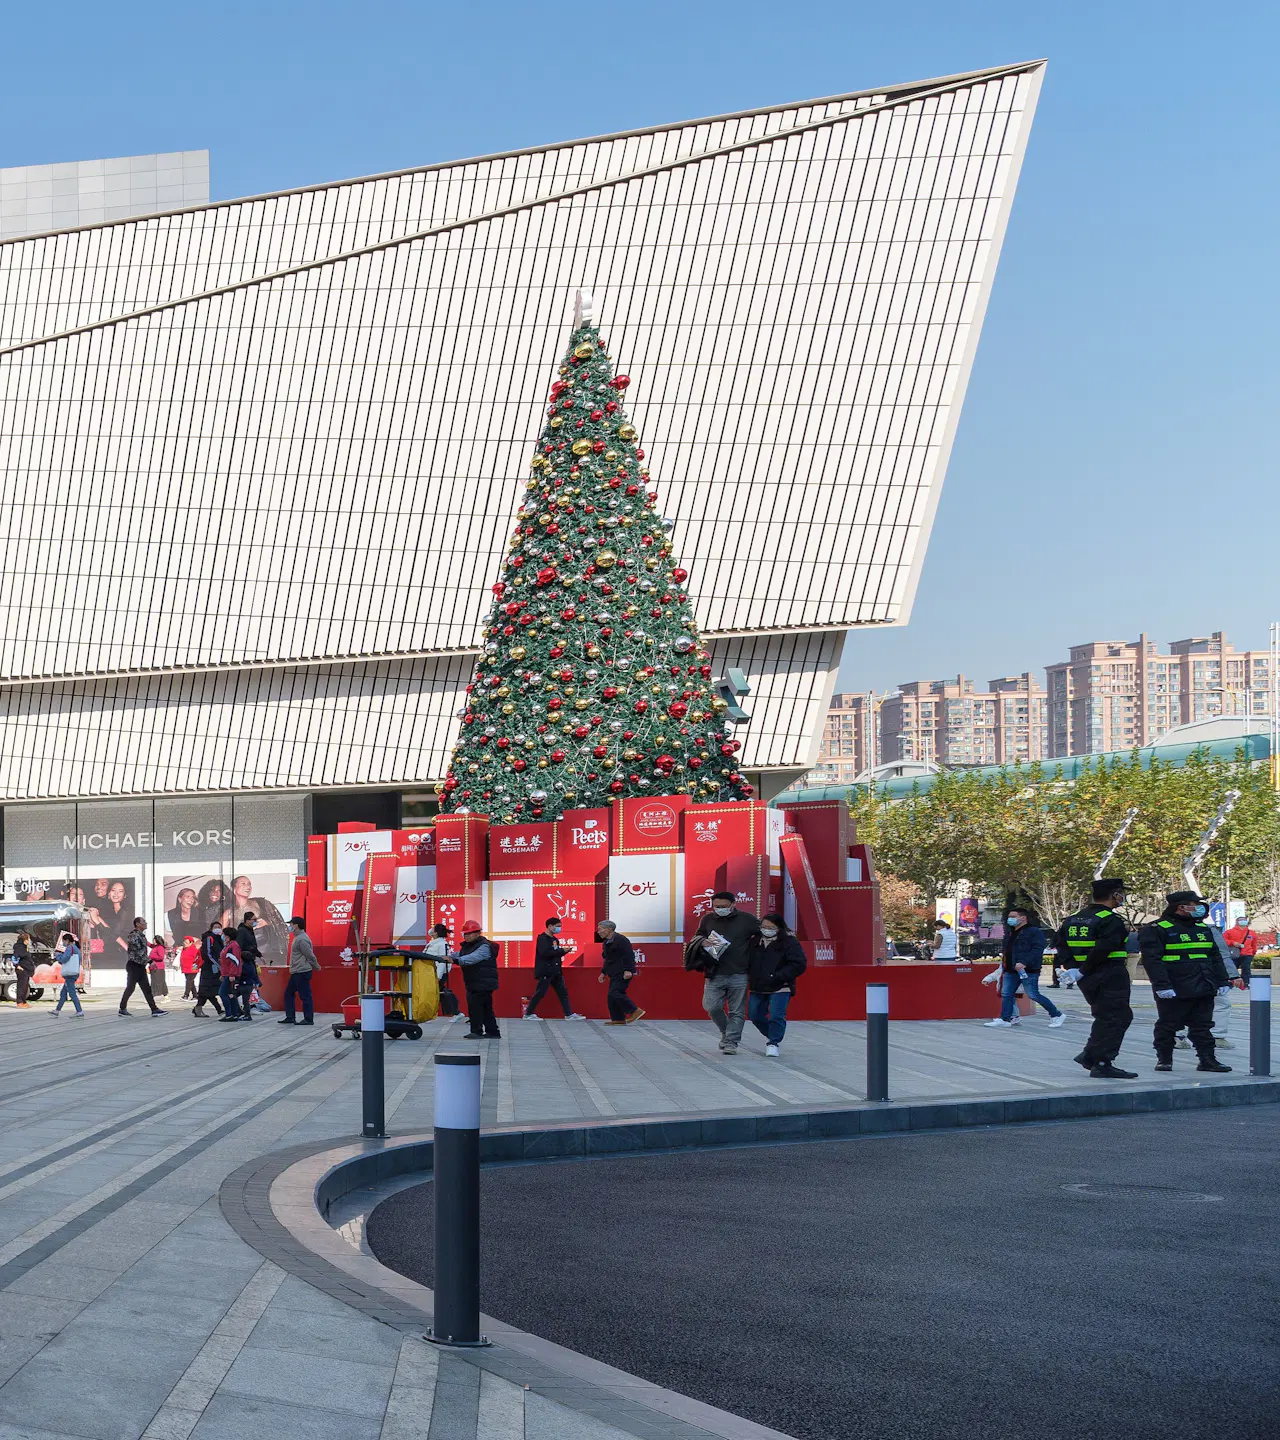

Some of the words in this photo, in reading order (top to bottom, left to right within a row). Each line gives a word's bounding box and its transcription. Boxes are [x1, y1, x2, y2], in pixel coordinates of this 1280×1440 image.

[63, 831, 163, 850] MICHAEL
[172, 828, 236, 847] KORS
[439, 837, 462, 846] 太二
[571, 827, 608, 845] Peet's
[344, 840, 371, 852] 久光
[502, 846, 540, 854] ROSEMARY
[618, 881, 658, 896] 久光
[399, 891, 427, 904] 久光
[500, 897, 526, 908] 久光
[1068, 926, 1089, 937] 保安
[1179, 933, 1207, 942] 保安
